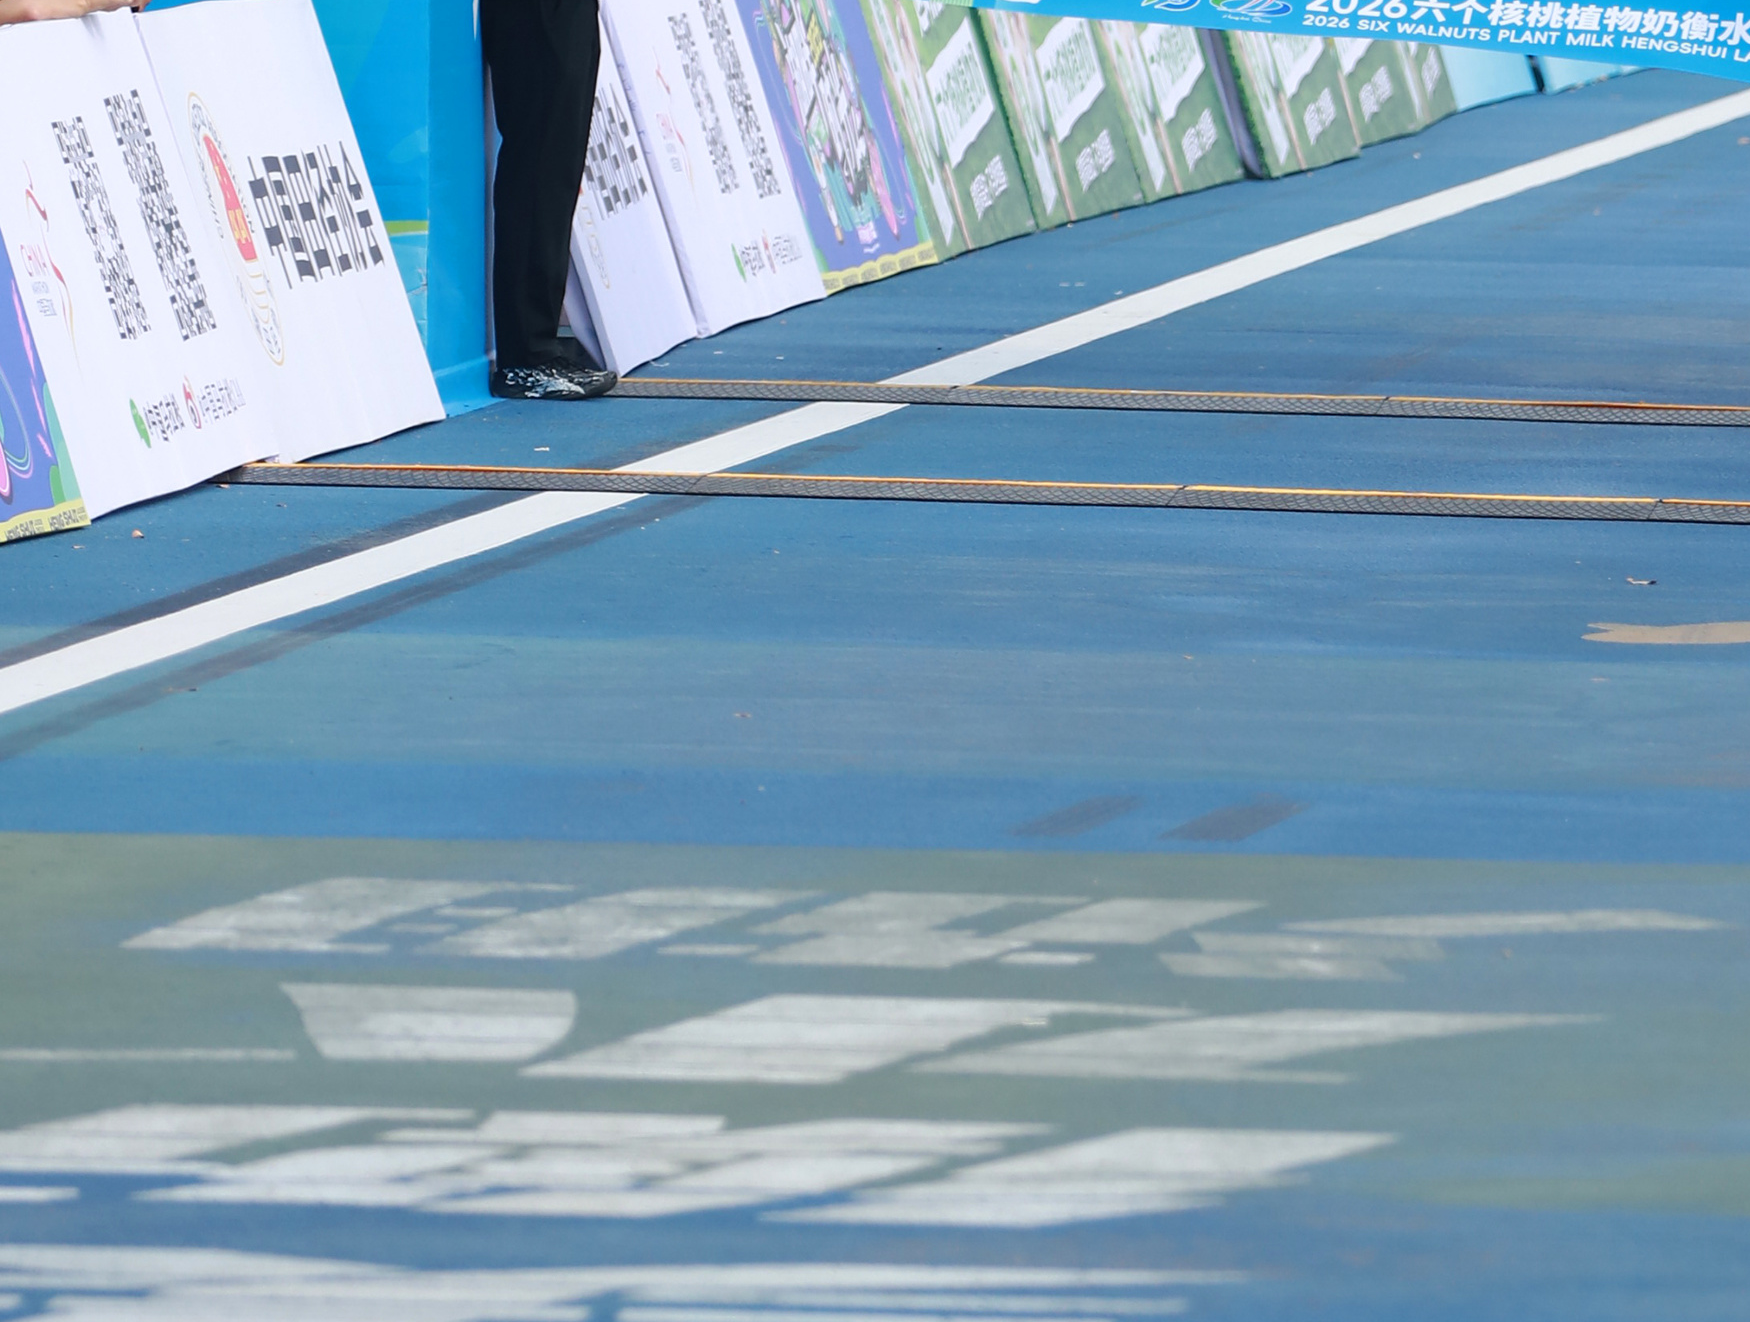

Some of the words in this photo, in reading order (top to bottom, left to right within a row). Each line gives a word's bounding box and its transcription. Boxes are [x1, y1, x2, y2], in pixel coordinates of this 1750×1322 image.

[1302, 14, 1351, 29] 2026
[1357, 19, 1390, 33] SIX
[1397, 22, 1491, 41] WALNUTS
[1497, 29, 1560, 45] PLANT
[1566, 33, 1615, 48] MILK
[1621, 35, 1727, 59] HENGSHUI
[247, 141, 385, 290] 中国田径协会
